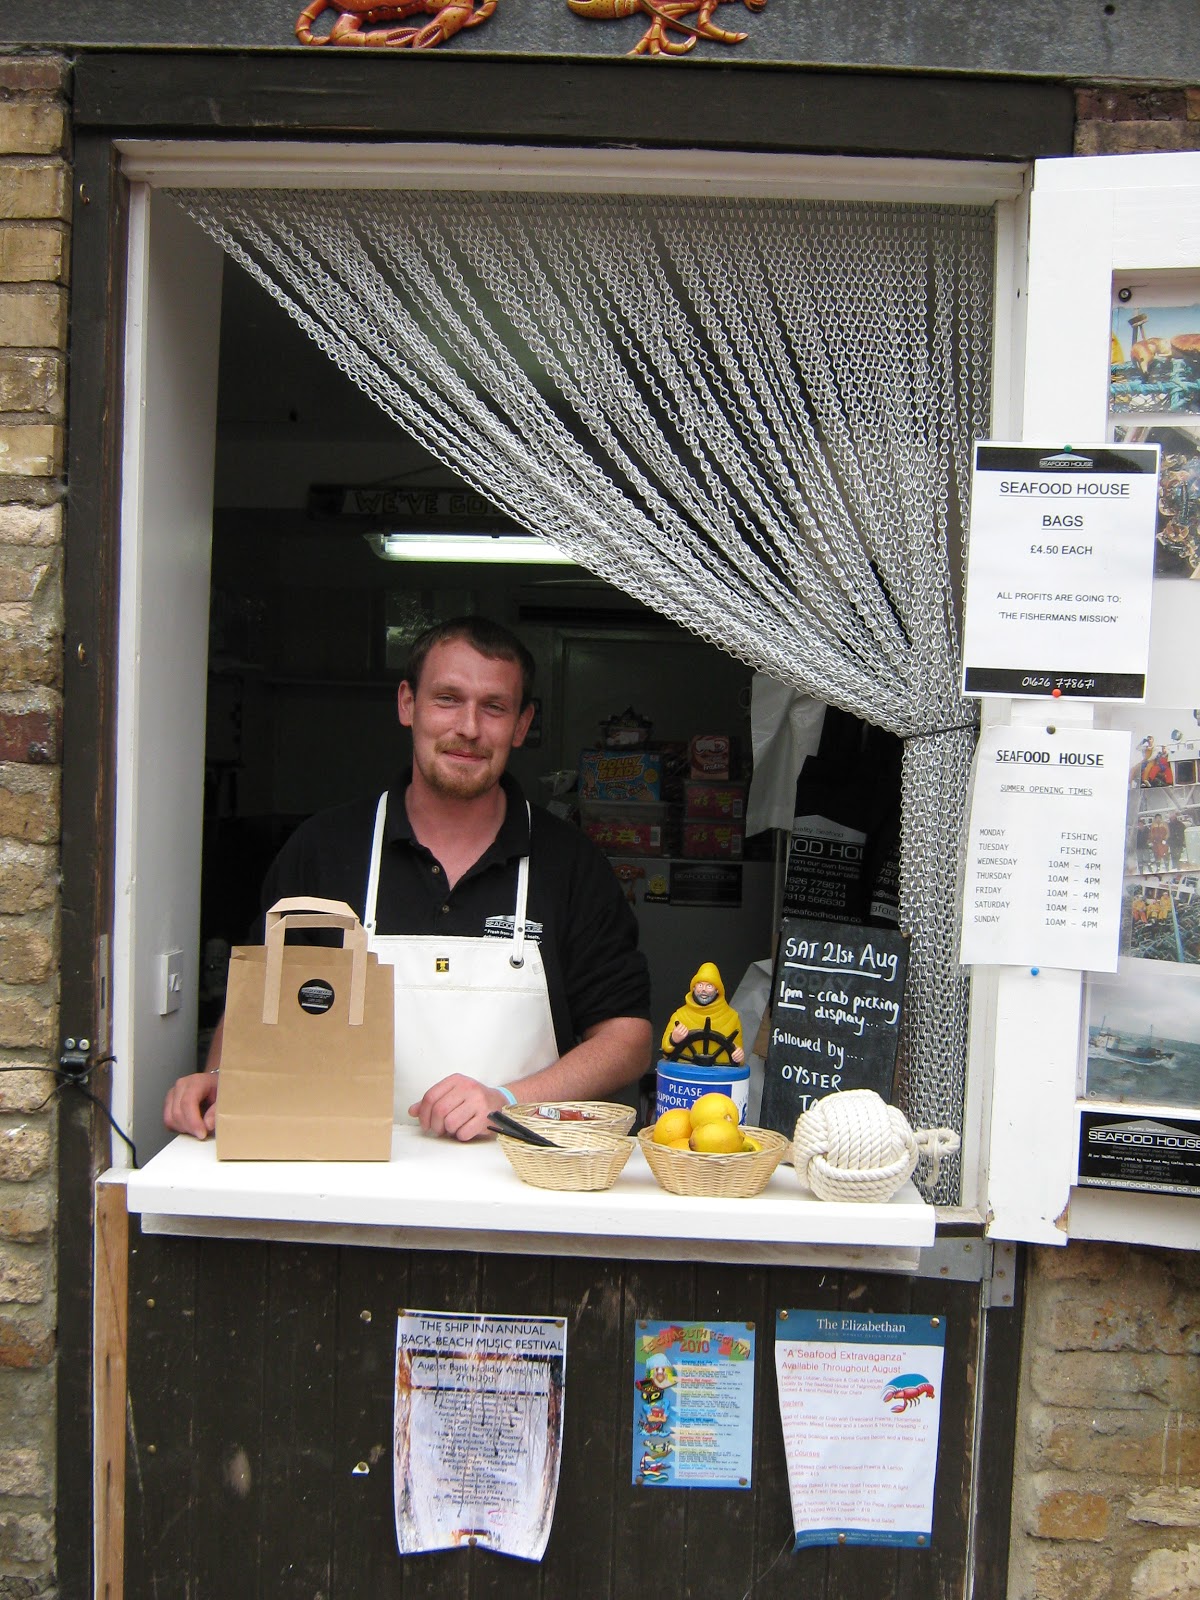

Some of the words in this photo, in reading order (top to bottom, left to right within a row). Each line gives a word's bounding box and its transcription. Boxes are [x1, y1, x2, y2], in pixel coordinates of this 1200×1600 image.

[1000, 481, 1072, 496] SEAFOOD
[1076, 483, 1130, 496] HOUSE
[1042, 515, 1083, 528] BAGS
[1030, 545, 1059, 555] £4.50
[1061, 545, 1093, 555] EACH
[997, 592, 1013, 600] ALL
[1015, 592, 1053, 601] PROFITS
[1055, 593, 1073, 602] ARE
[1075, 594, 1105, 603] GOING
[1107, 595, 1122, 603] TO:
[1020, 613, 1077, 622] FISHERMANS
[1021, 676, 1051, 688] 01626
[1055, 677, 1095, 689] 778671
[996, 749, 1051, 764] SEAFOOD
[1059, 752, 1104, 766] HOUSE
[1000, 784, 1025, 793] SUMMER
[1029, 785, 1064, 795] OPENING
[1069, 787, 1093, 796] TIMES
[979, 829, 1005, 837] MONDAY
[1061, 832, 1098, 841] FISHING
[790, 838, 824, 855] OD
[979, 843, 1009, 851] TUESDAY
[1060, 846, 1097, 856] FISHING
[977, 857, 1018, 866] WEDNESDAY
[1048, 860, 1070, 869] 10AM
[1084, 862, 1101, 871] 4PM
[976, 872, 1012, 880] THURSDAY
[1047, 875, 1069, 883] 10AM
[1084, 877, 1100, 885] 4PM
[975, 886, 1002, 894] FRIDAY
[1046, 889, 1068, 898] 10AM
[1083, 891, 1099, 900] 4PM
[974, 900, 1011, 909] SATURDAY
[1045, 903, 1067, 912] 10AM
[1082, 906, 1099, 914] 4PM
[974, 915, 1001, 923] SUNDAY
[1045, 918, 1066, 926] 10AM
[1081, 920, 1098, 928] 4PM
[785, 937, 820, 959] SAT
[821, 941, 855, 964] 21st
[860, 943, 899, 981] Aug
[780, 981, 803, 1002] 1pm
[817, 990, 848, 1005] crab
[853, 996, 900, 1025] picking
[772, 1028, 822, 1053] followed
[782, 1065, 841, 1092] OYSTER
[669, 1083, 702, 1097] PLEASE
[657, 1091, 688, 1107] SUPPORT
[1088, 1131, 1153, 1144] SEAFOOD
[1157, 1137, 1200, 1149] HOUSE
[1086, 1178, 1200, 1194] www.seafoodhouse.co.uk
[420, 1320, 442, 1332] THE
[445, 1321, 469, 1333] SHIP
[472, 1323, 494, 1334] INN
[495, 1324, 546, 1336] ANNUAL
[817, 1318, 838, 1330] The
[841, 1319, 907, 1333] Elizabethan
[401, 1333, 473, 1347] BACK-BEACH
[476, 1337, 512, 1349] MUSIC
[680, 1340, 710, 1354] 2010
[797, 1349, 837, 1360] Seafood
[417, 1361, 447, 1373] August
[449, 1362, 469, 1373] Bank
[781, 1361, 819, 1371] Available
[822, 1363, 870, 1374] Throughout
[872, 1365, 901, 1375] August
